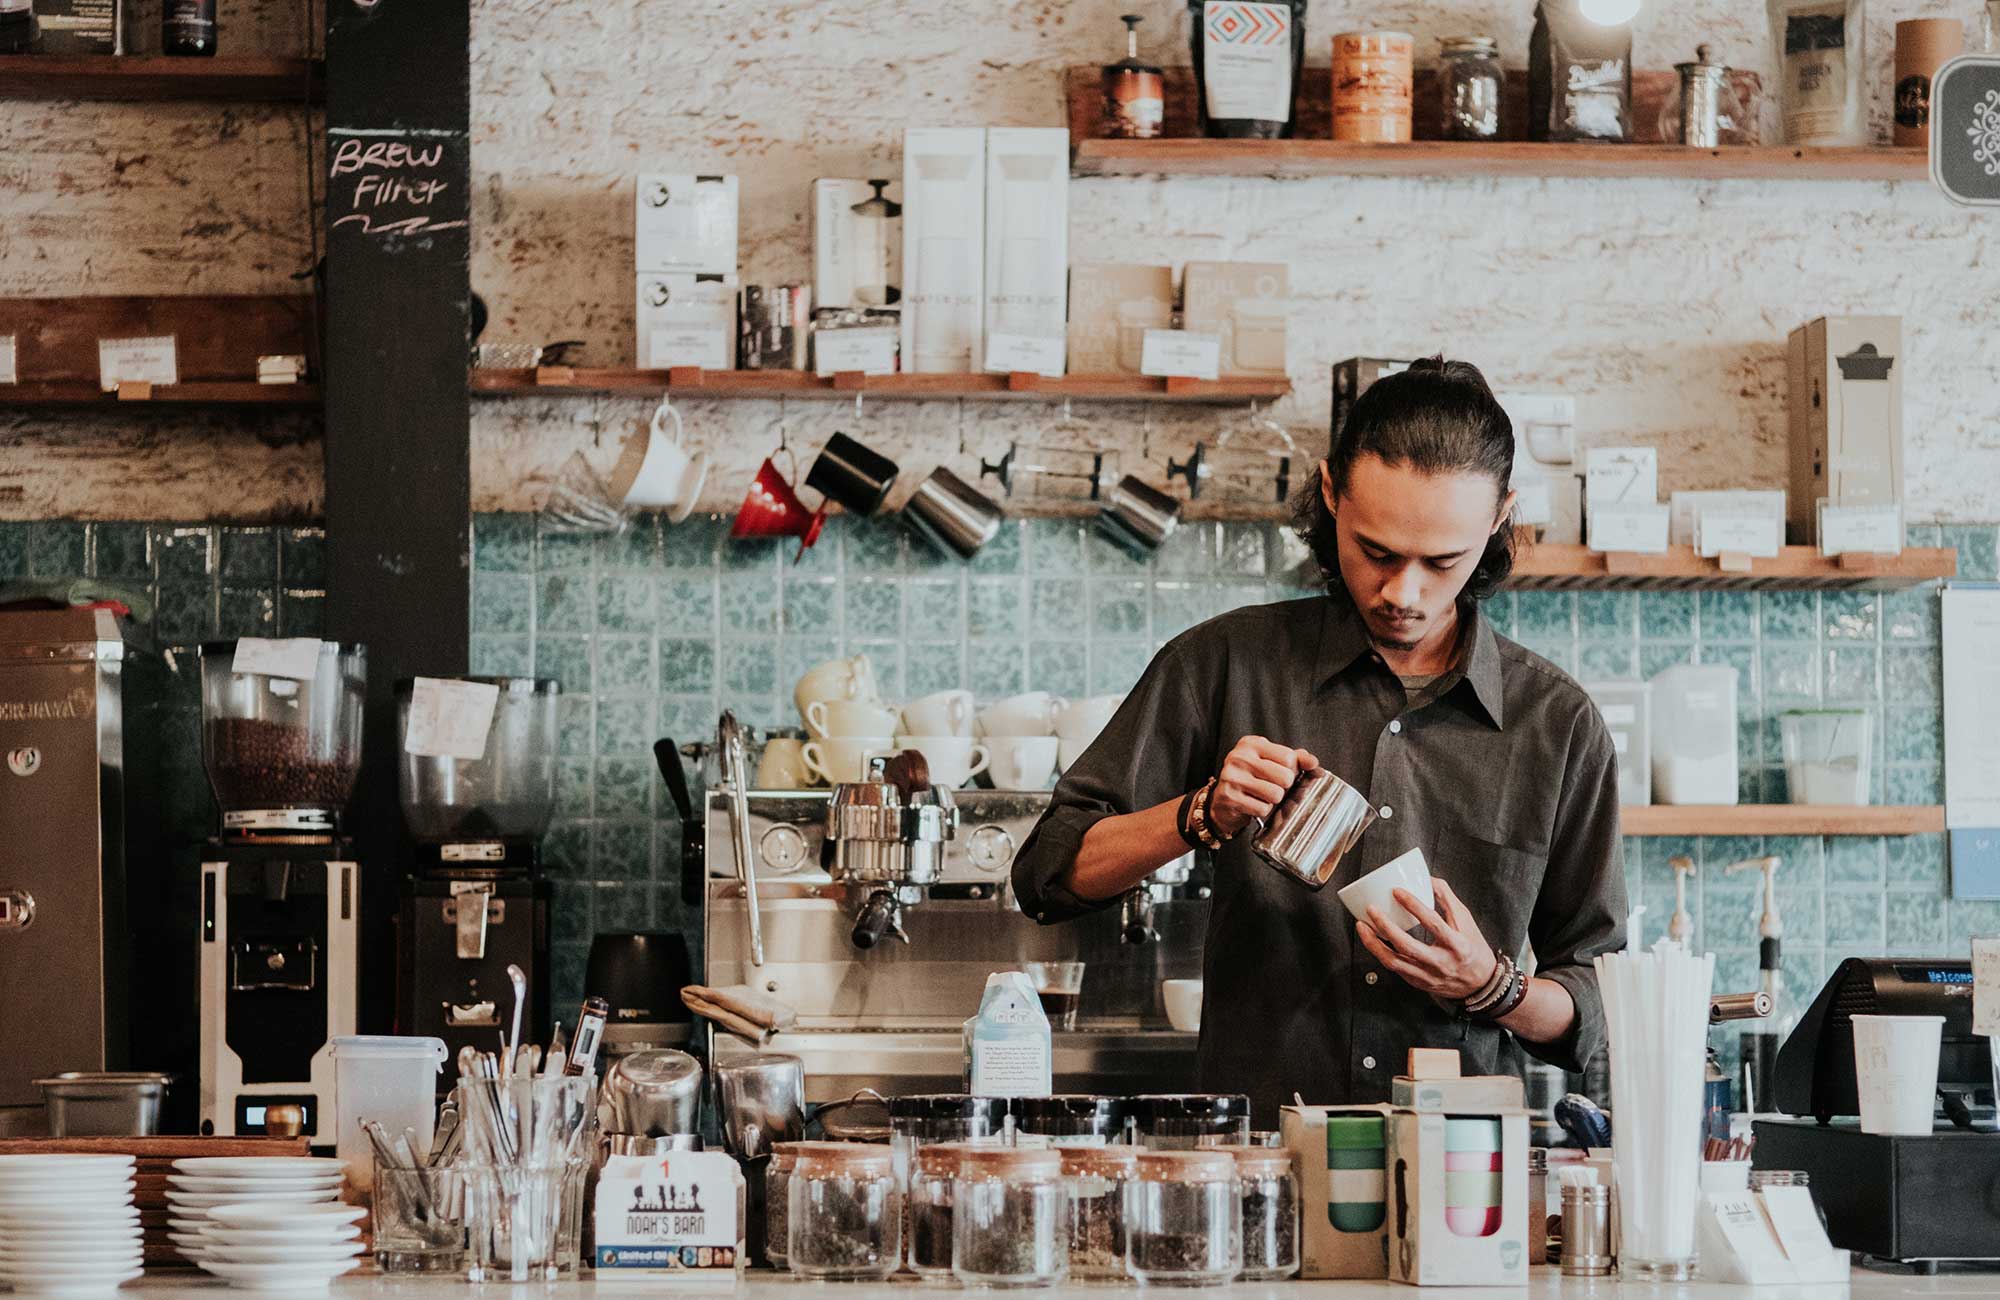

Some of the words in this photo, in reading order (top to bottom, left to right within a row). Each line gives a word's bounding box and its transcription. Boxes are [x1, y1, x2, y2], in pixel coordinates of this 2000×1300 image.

[660, 1159, 670, 1179] 1
[626, 1215, 669, 1236] NOAH'S
[674, 1215, 705, 1236] BARN
